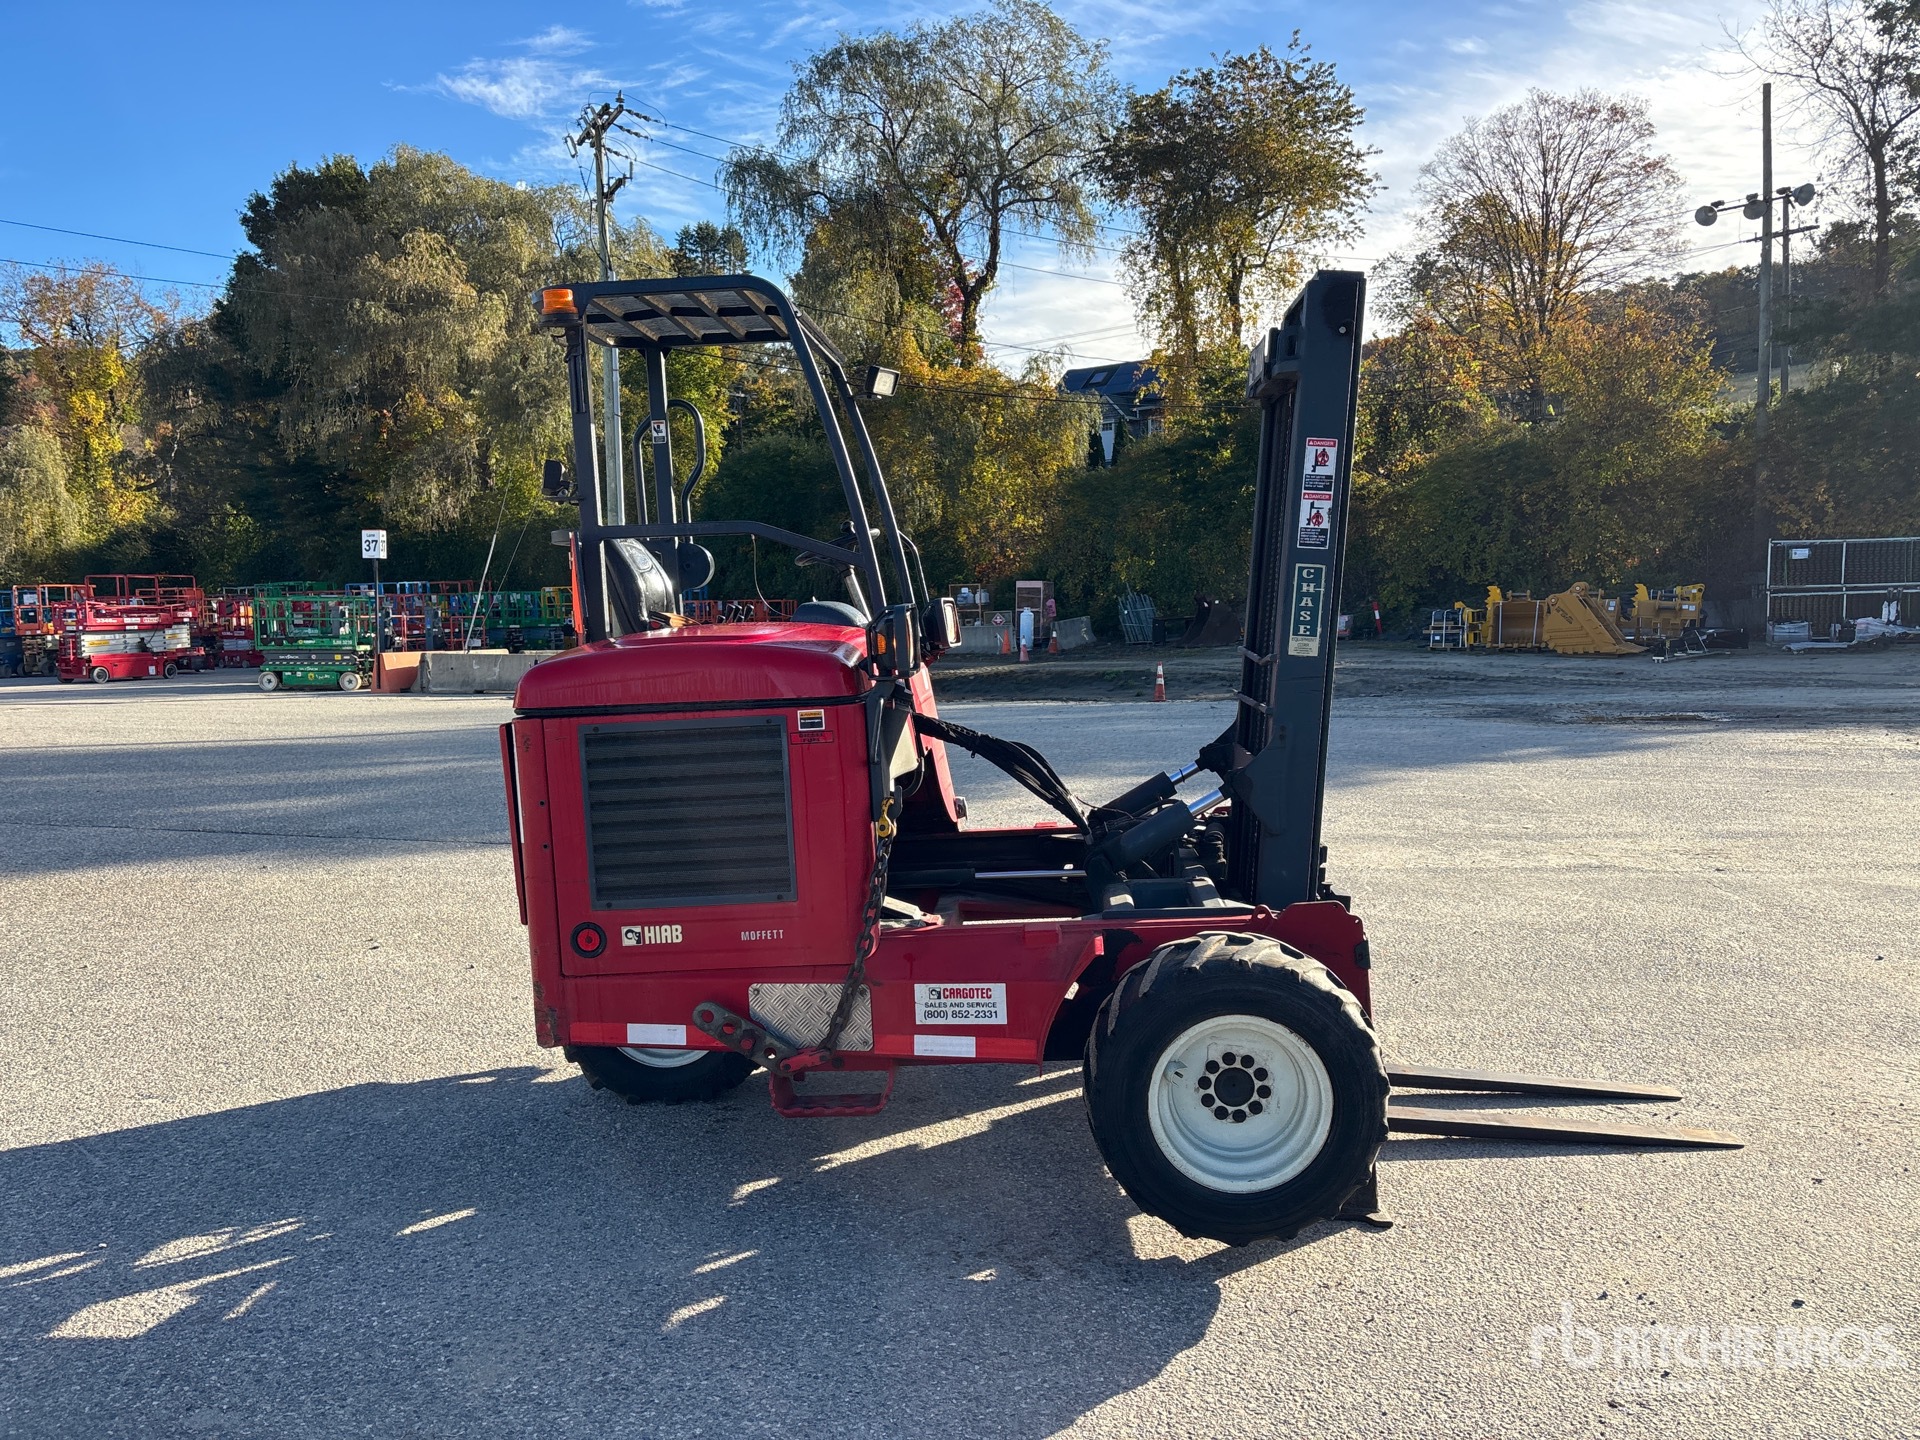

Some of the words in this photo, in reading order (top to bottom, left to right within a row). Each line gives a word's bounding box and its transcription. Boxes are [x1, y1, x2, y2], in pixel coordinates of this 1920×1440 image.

[364, 539, 379, 552] 37
[1297, 568, 1316, 636] CHASE
[644, 924, 683, 944] HIAB
[741, 929, 784, 941] MOFFETT
[942, 987, 992, 1000] CARGOTEC
[923, 1010, 949, 1021] (800)
[951, 1010, 998, 1019] 852-2331
